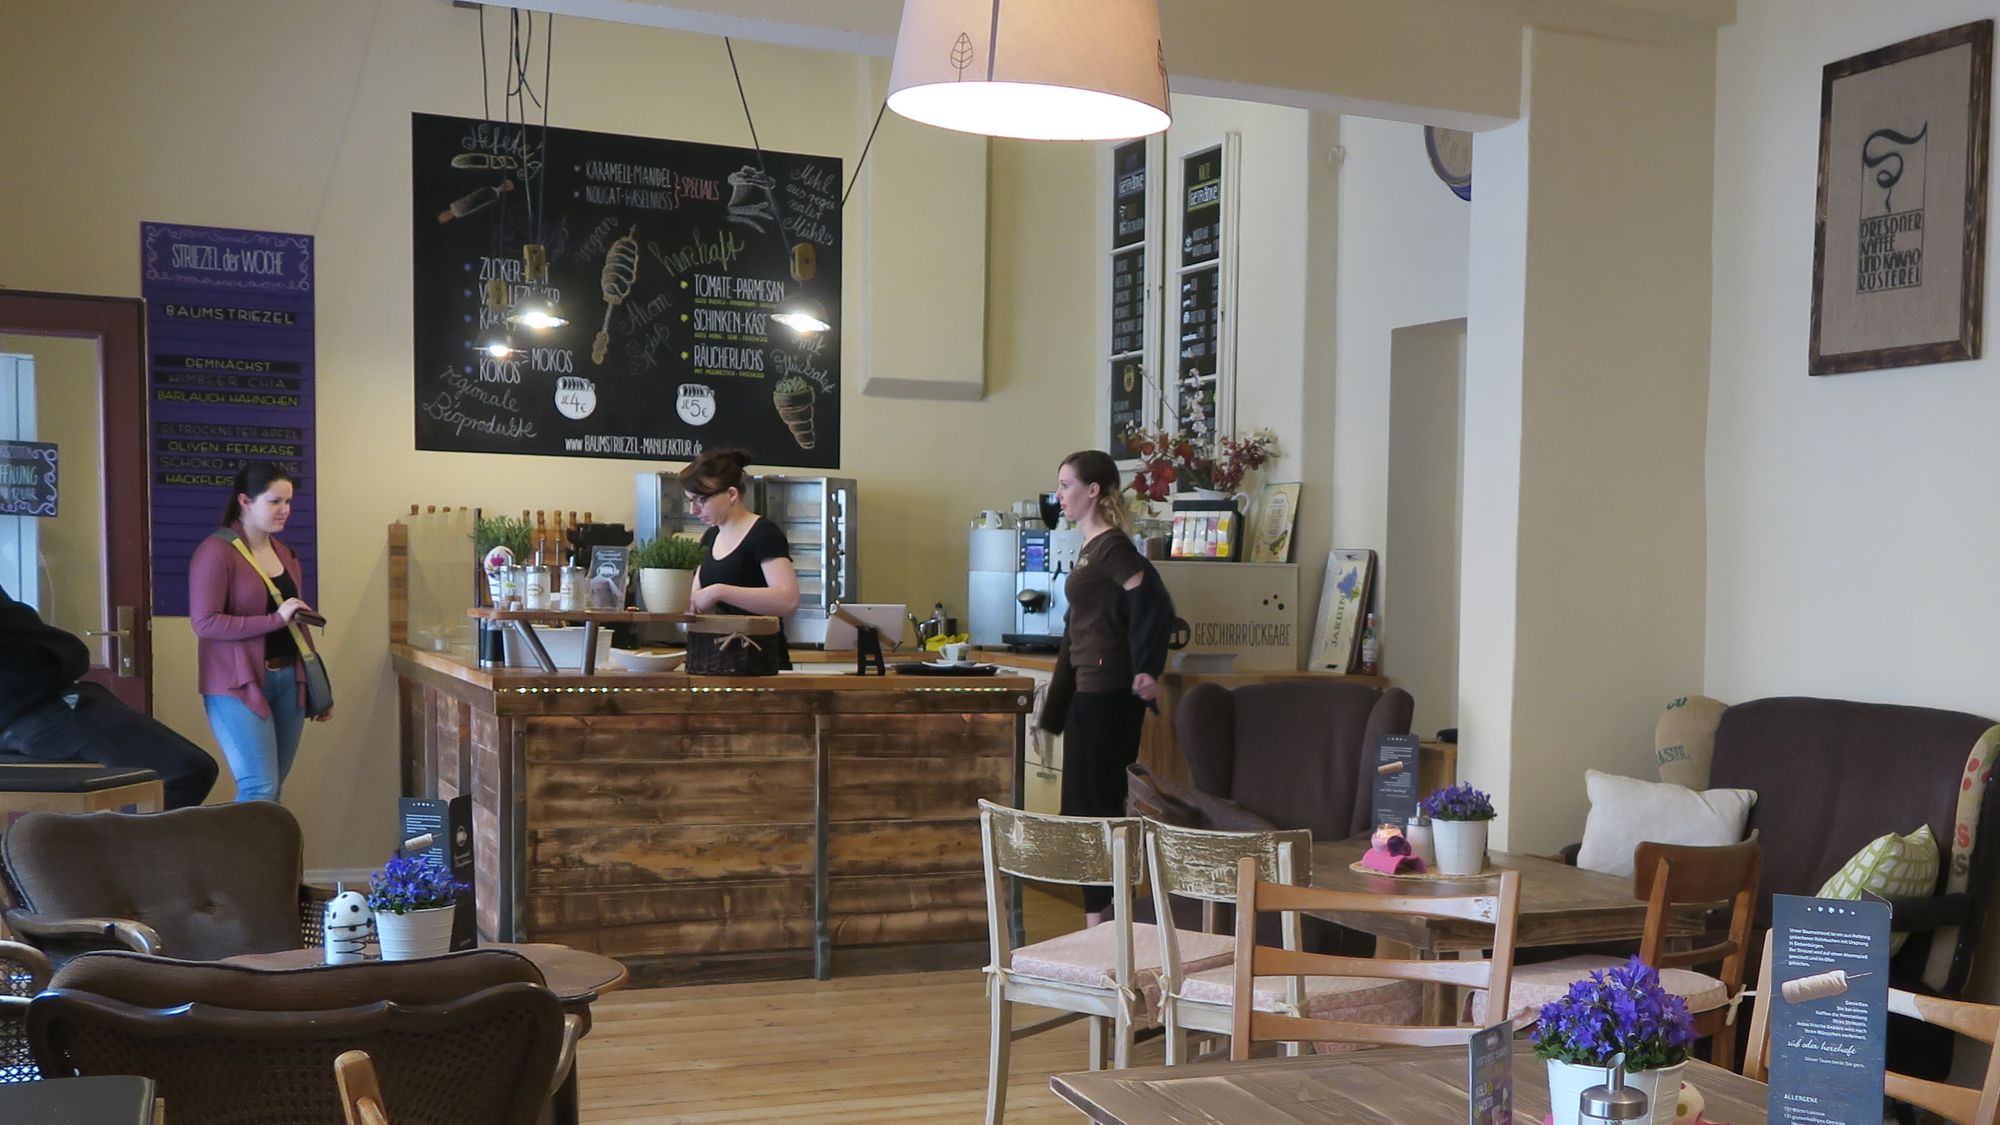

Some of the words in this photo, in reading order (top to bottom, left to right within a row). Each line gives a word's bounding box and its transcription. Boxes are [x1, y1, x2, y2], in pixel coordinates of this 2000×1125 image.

[585, 160, 671, 188] KARAMELL-MANDEL
[680, 176, 720, 201] SPECIALS
[1860, 212, 1922, 239] DRESDNER
[1860, 233, 1896, 256] KAFFEE
[172, 243, 222, 271] STRIEZEL
[222, 248, 240, 272] der
[240, 249, 285, 275] WOCHE
[1859, 255, 1881, 274] UND
[1883, 249, 1921, 270] KAKAO
[693, 274, 785, 302] TOMATE-PARMESAN
[165, 305, 294, 325] BAUMSTRIEZEL
[531, 348, 573, 374] MOKOS
[693, 343, 764, 371] RÄUCHERLACHS
[479, 358, 521, 384] KOKOS
[168, 440, 219, 453] OLIVEN
[159, 457, 224, 470] SCHOKO
[1194, 621, 1292, 647] GESCHIRRRÜCKGABE
[1331, 595, 1346, 648] JARDIN
[1783, 1093, 1818, 1104] ALLERGENE
